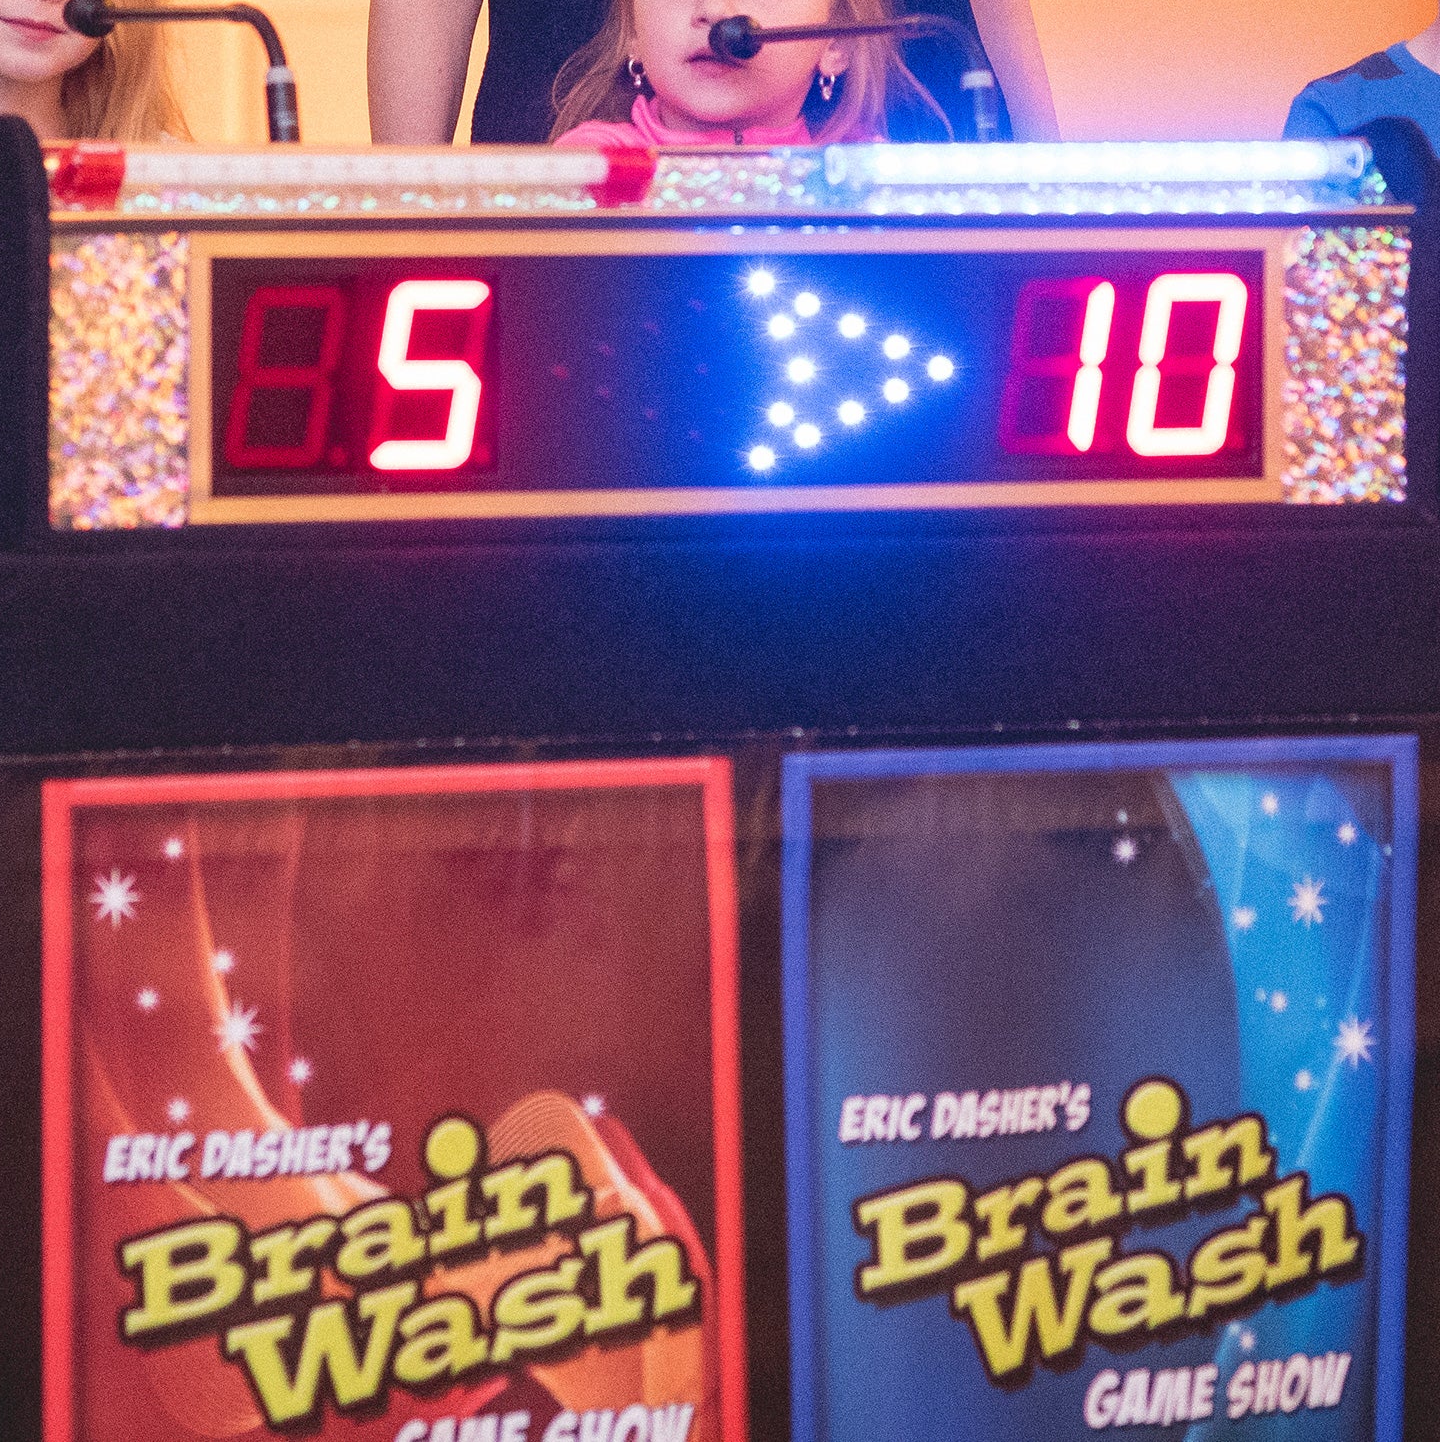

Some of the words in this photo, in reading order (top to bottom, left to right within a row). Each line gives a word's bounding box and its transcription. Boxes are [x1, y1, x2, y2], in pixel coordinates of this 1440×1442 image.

[369, 279, 491, 470] 5
[1067, 272, 1249, 457] 10
[103, 1129, 190, 1183] ERIC
[200, 1120, 392, 1179] DASHER'S
[839, 1093, 925, 1143] ERIC
[931, 1082, 1092, 1139] DASHER'S
[858, 1080, 1272, 1293] Brain
[121, 1117, 588, 1337] Brain
[226, 1217, 696, 1424] Wash
[956, 1176, 1360, 1377] Wash
[1082, 1362, 1219, 1429] GAME
[1226, 1350, 1352, 1420] SHOW
